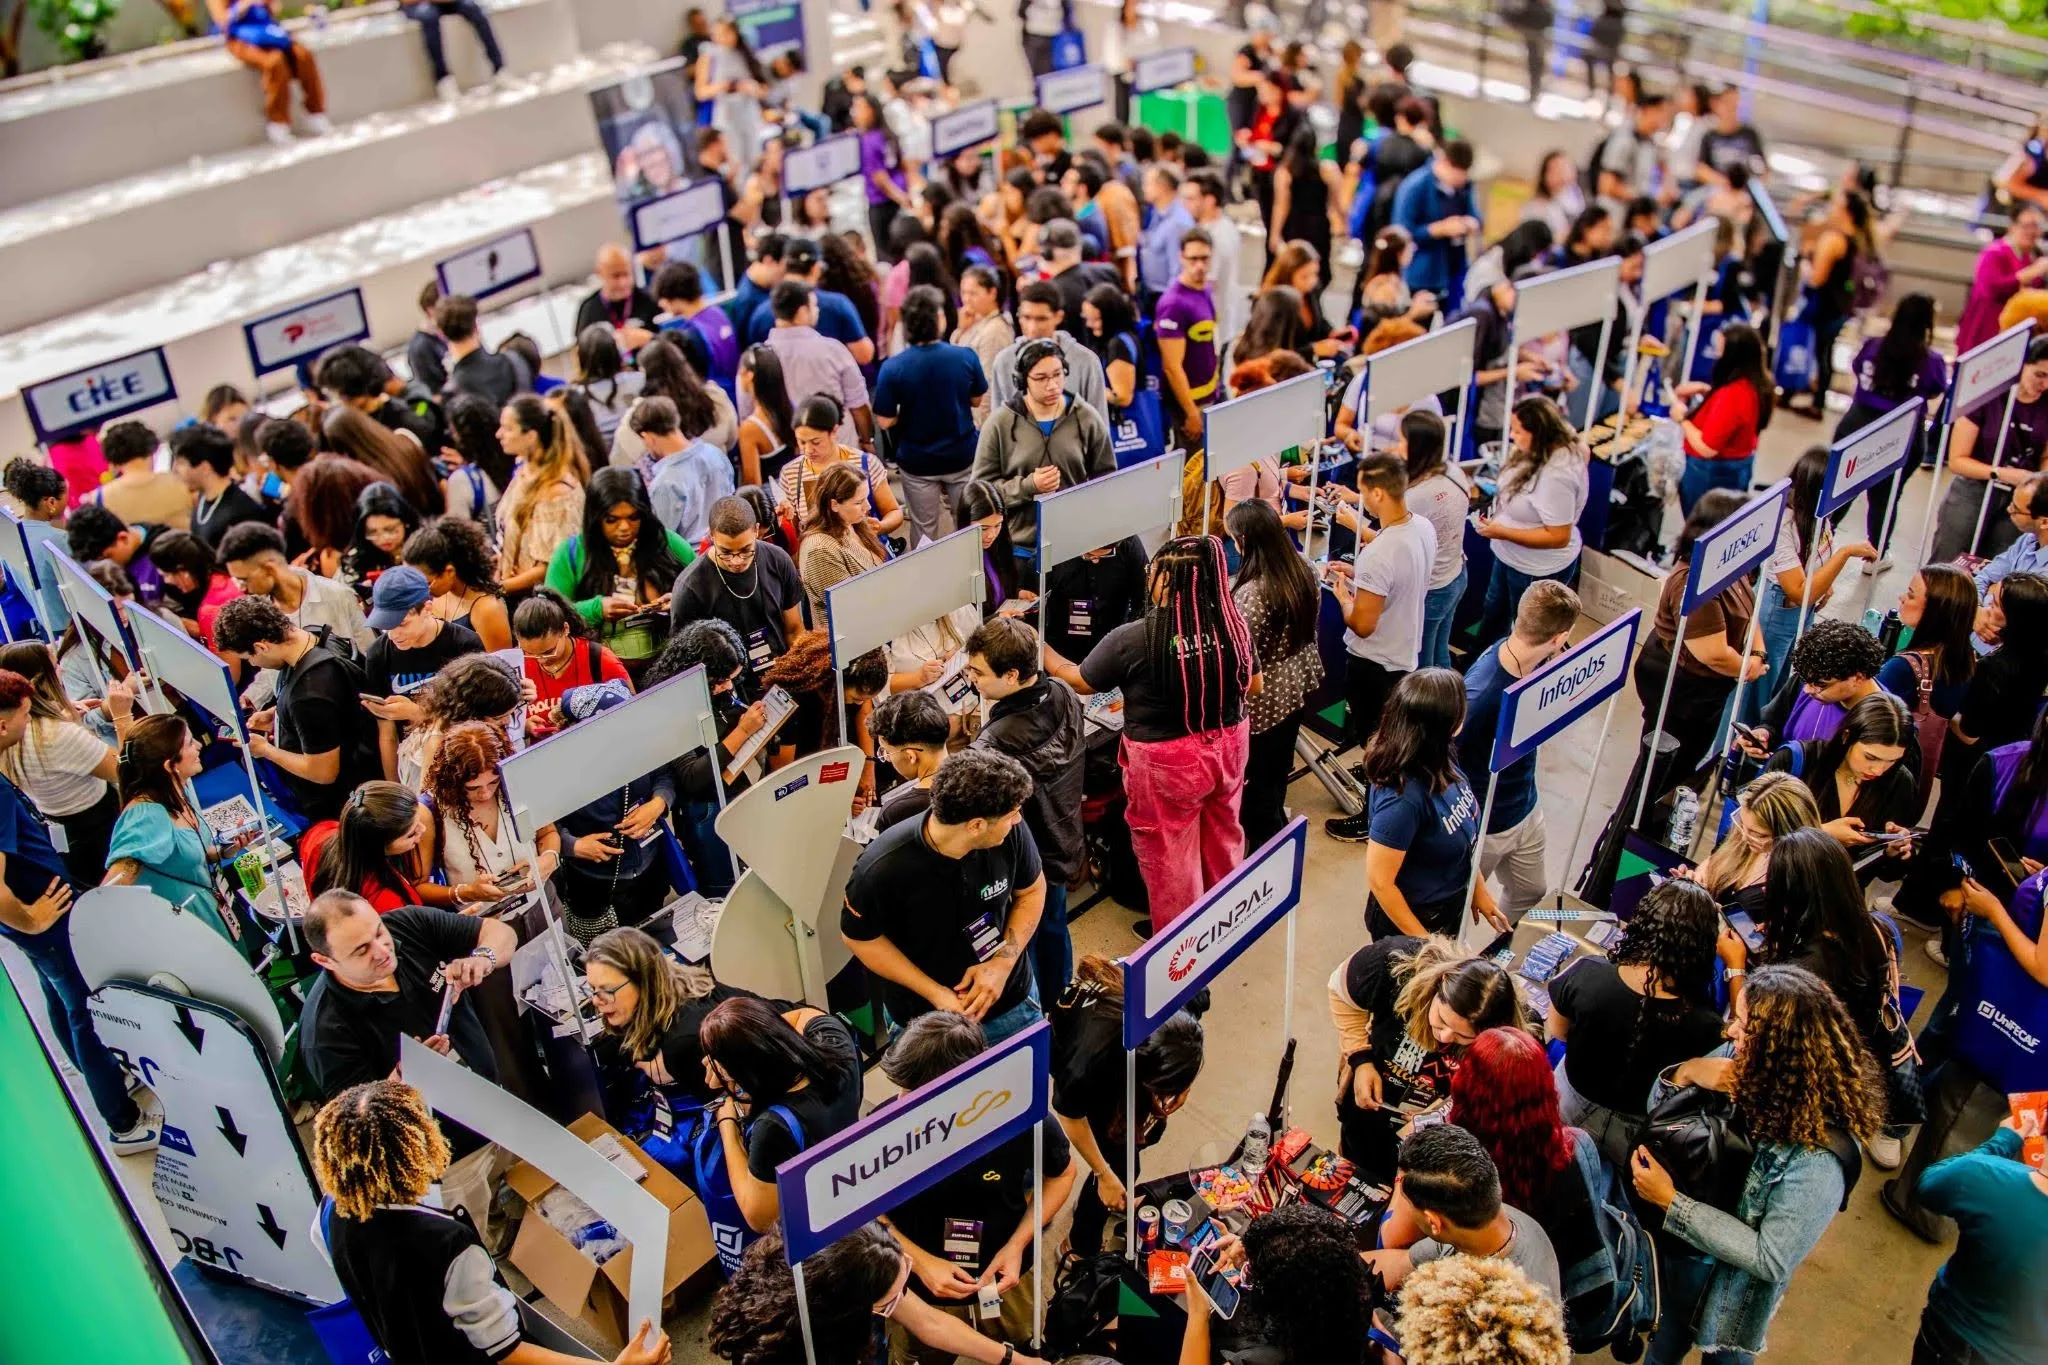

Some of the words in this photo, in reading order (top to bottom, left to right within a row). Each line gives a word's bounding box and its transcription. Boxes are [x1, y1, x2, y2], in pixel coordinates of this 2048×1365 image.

[1716, 523, 1764, 569] AIESEC
[1538, 653, 1607, 711] Infojobs
[1442, 785, 1475, 835] Infojobs
[1196, 880, 1273, 953] CINPAL
[1994, 1010, 2041, 1048] UniFECAF
[832, 1112, 957, 1198] Nublify
